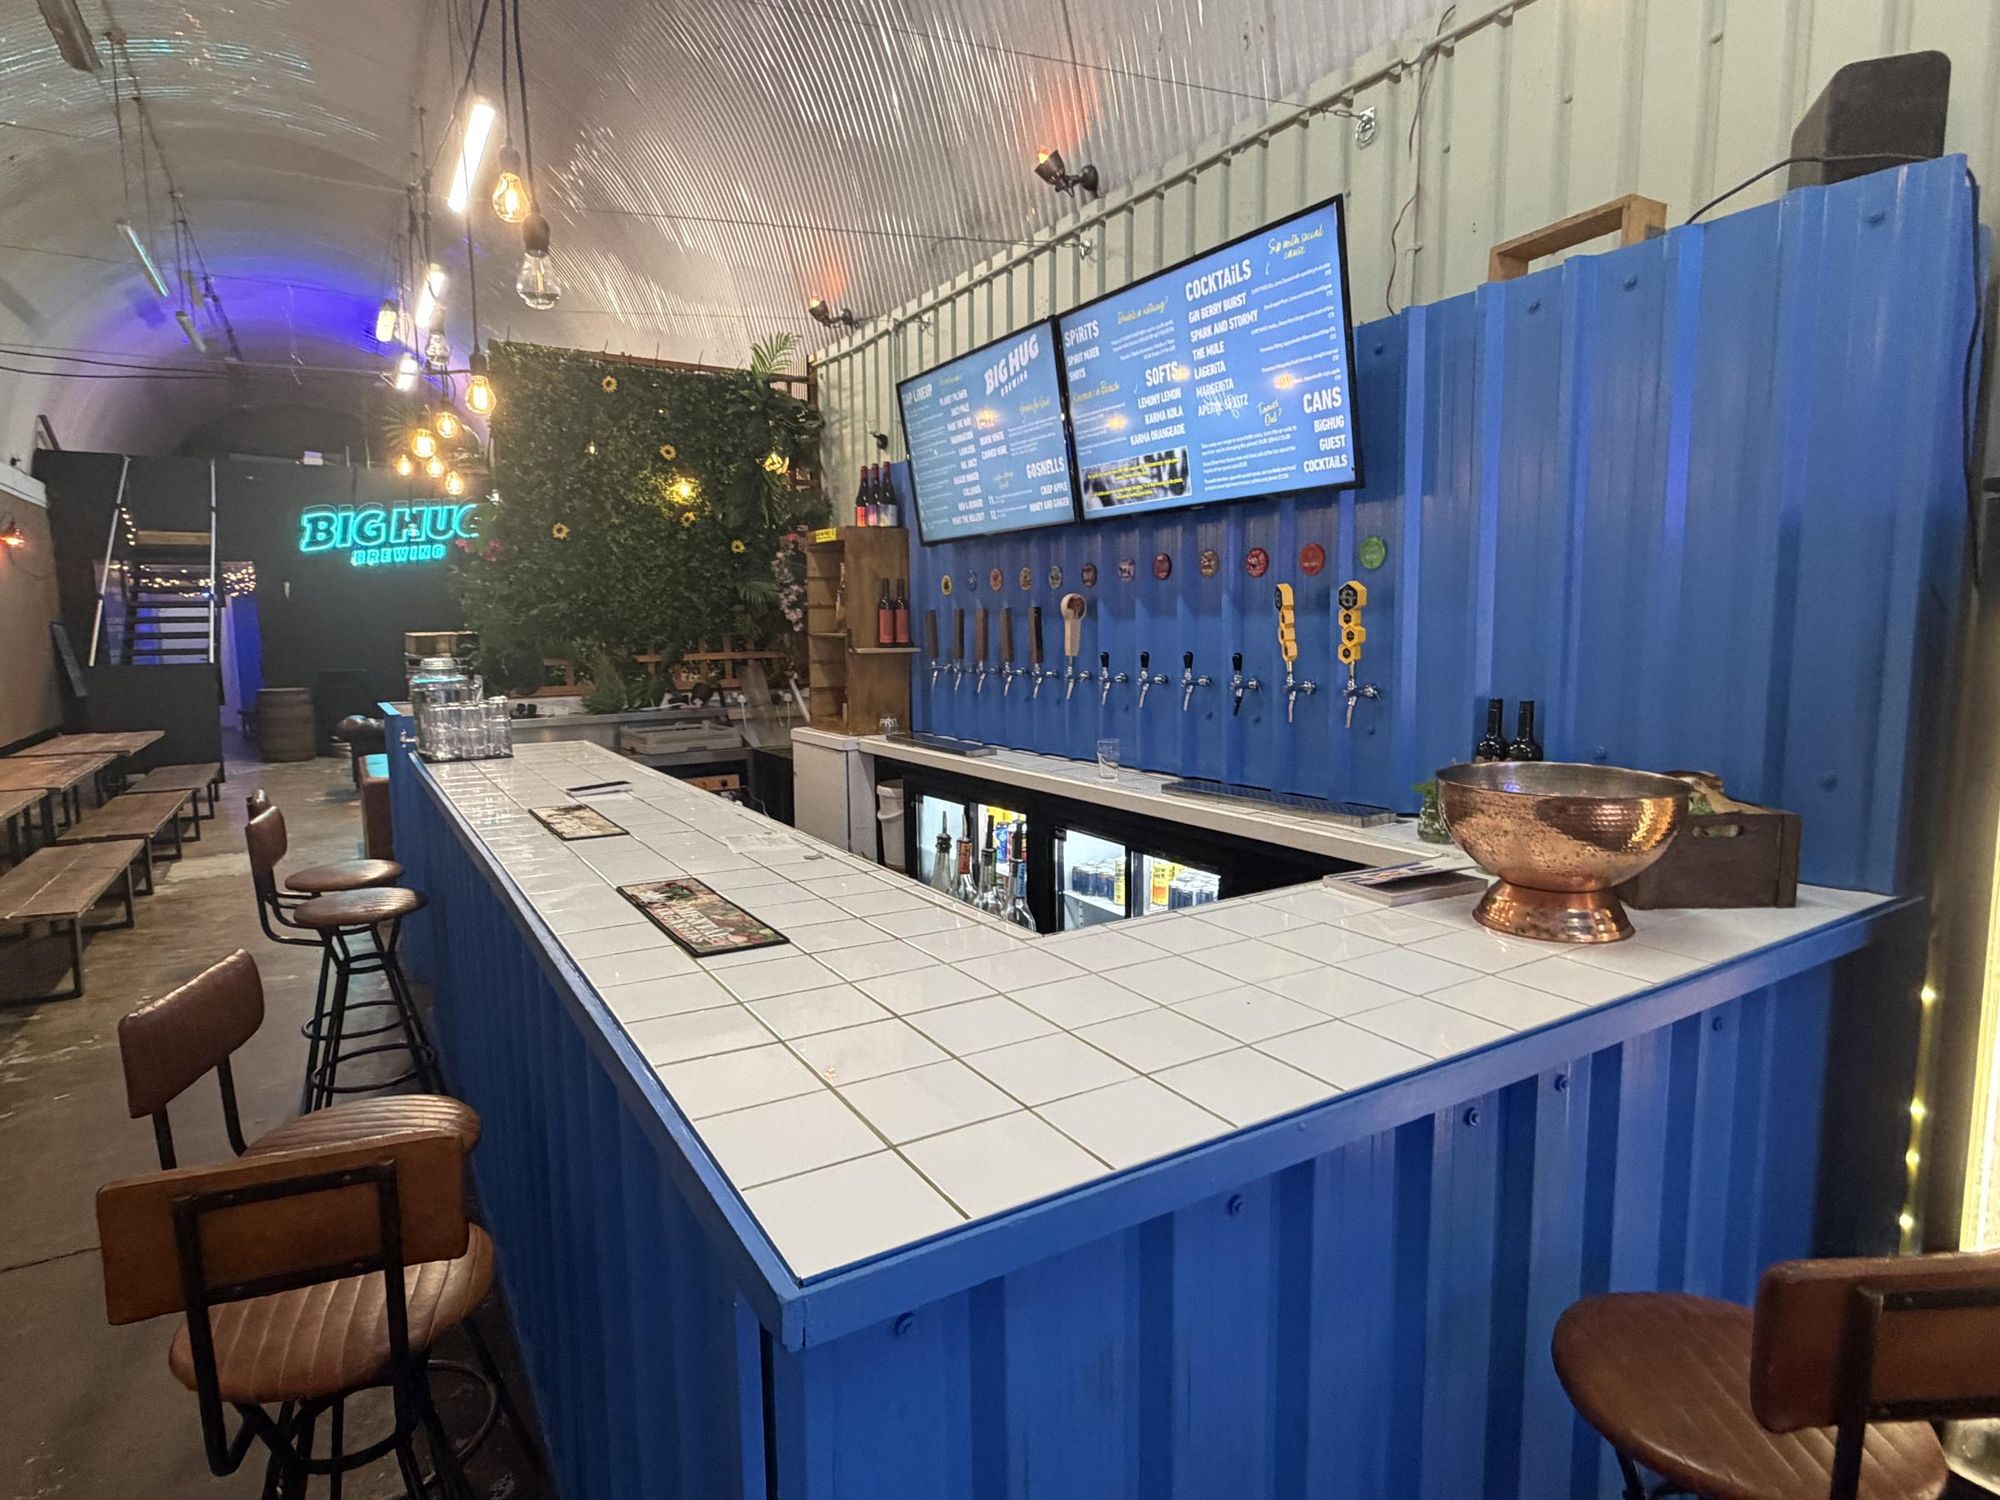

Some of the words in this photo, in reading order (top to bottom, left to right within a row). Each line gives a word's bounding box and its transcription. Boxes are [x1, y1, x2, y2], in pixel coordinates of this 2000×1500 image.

[1190, 324, 1213, 343] SPARK
[1213, 319, 1228, 336] AND
[1228, 308, 1259, 331] STORMY
[984, 357, 1008, 397] BIG
[1008, 333, 1039, 377] HUG
[1192, 346, 1206, 361] THE
[1145, 360, 1178, 387] SOFTS
[1160, 387, 1182, 403] LEMON
[1302, 386, 1342, 414] CANS
[1319, 434, 1346, 451] GUEST
[1026, 456, 1065, 479] GOSNELLS
[300, 510, 386, 552] BIG
[351, 543, 446, 567] BREWING
